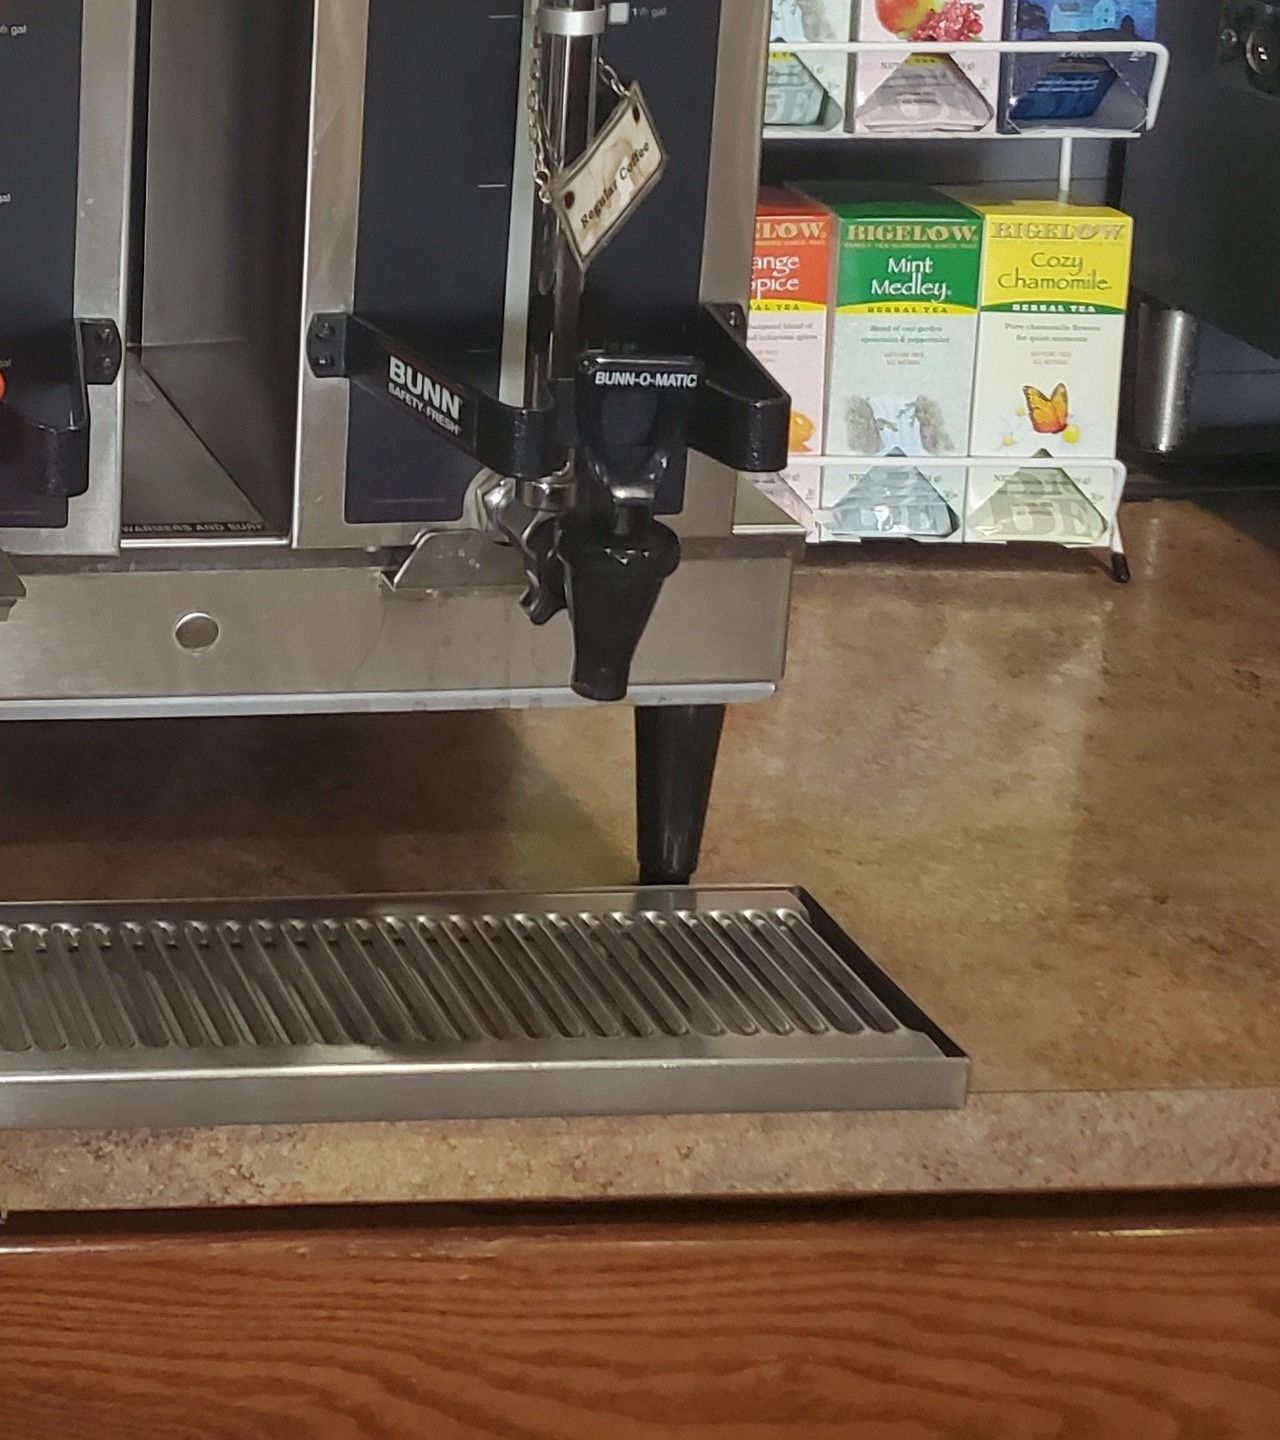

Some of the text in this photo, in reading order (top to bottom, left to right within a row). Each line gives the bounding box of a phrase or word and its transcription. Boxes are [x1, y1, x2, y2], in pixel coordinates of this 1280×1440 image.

[11, 24, 27, 36] gal
[619, 141, 650, 181] Coffee
[580, 179, 618, 229] Regular
[848, 224, 976, 240] BIGELOW
[990, 223, 1127, 240] BIGELOW
[752, 256, 800, 277] ange
[887, 255, 933, 273] Mint
[1031, 252, 1084, 276] Cozy
[871, 272, 947, 303] Medley
[998, 267, 1112, 290] Chamomile
[389, 355, 460, 420] BUNN
[595, 370, 698, 388] BUNN-O-MATIC
